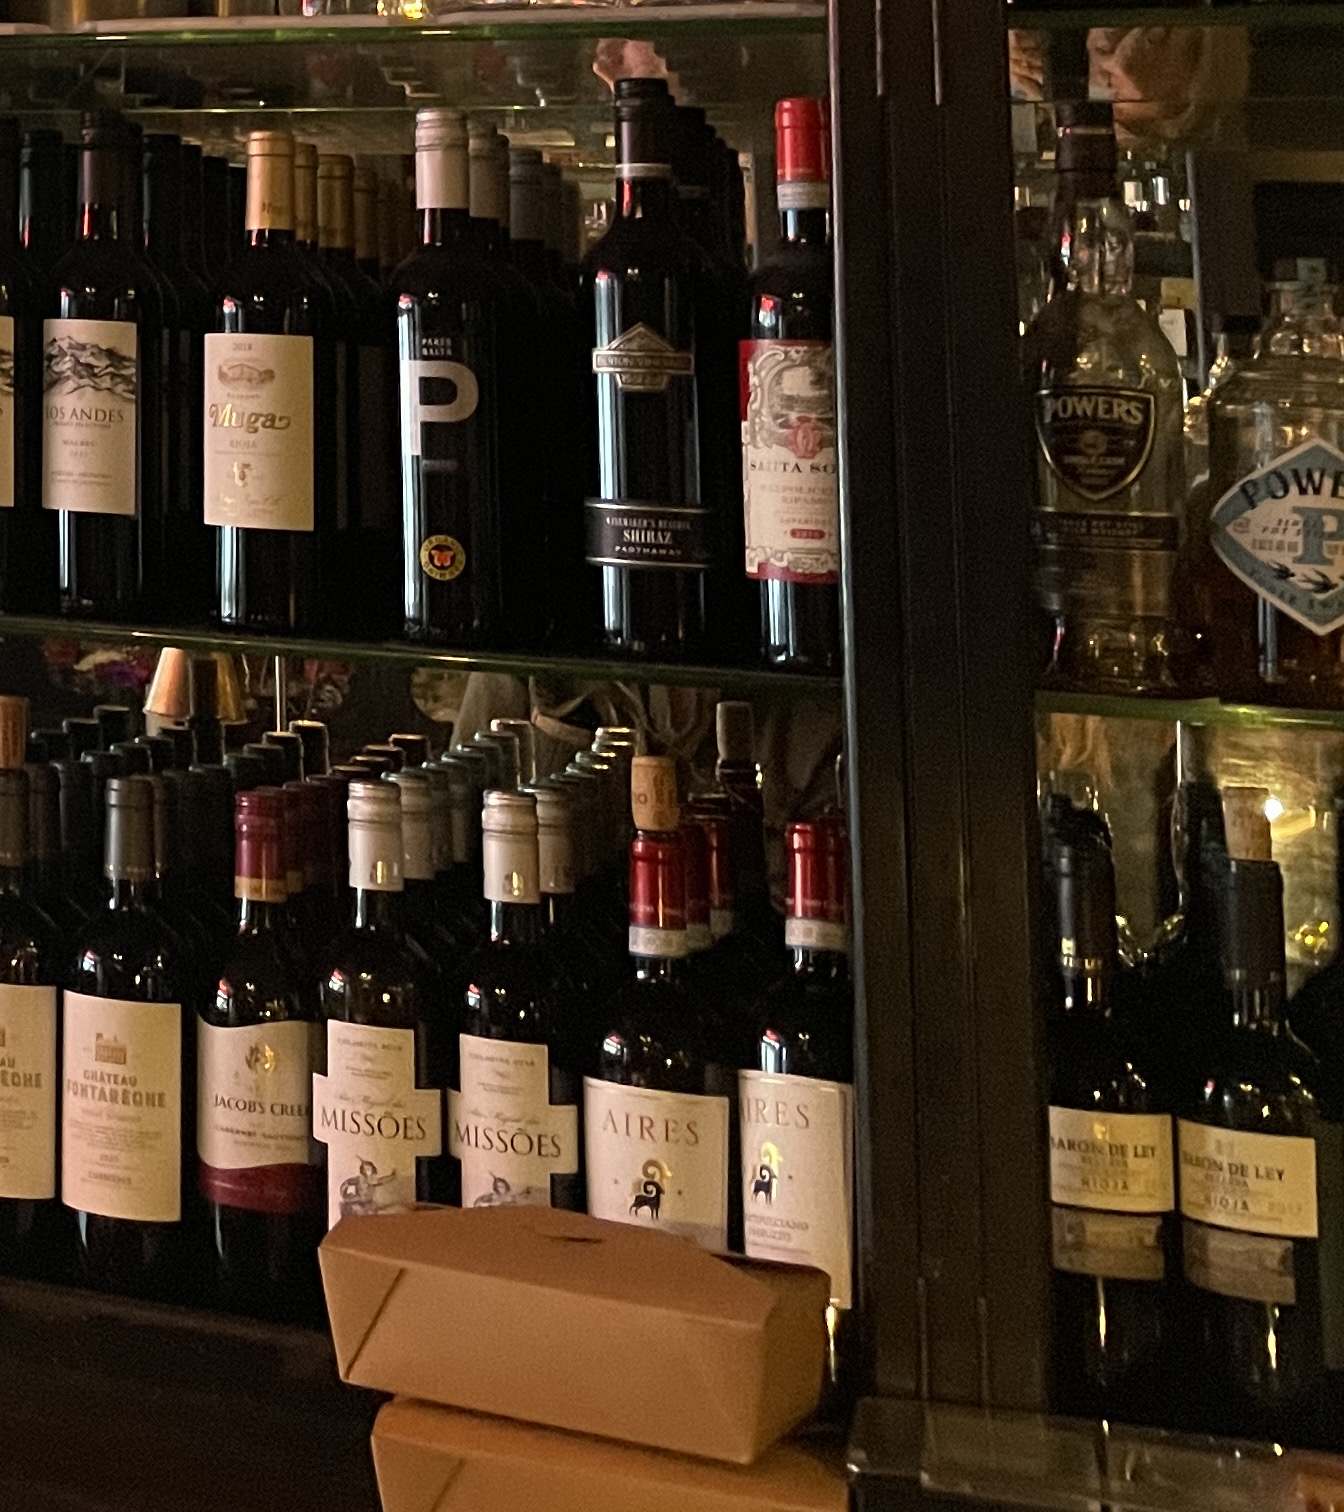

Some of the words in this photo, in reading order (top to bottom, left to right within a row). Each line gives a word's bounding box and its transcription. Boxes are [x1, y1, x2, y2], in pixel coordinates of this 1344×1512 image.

[46, 405, 69, 420] LOS
[72, 407, 124, 423] ANDES
[207, 404, 290, 433] Muga
[1043, 397, 1144, 424] POWERS
[623, 528, 673, 545] SHIRAZ
[214, 1093, 266, 1117] JACOB'S
[320, 1104, 427, 1142] MISSÕES
[601, 1106, 700, 1146] AIRES
[455, 1120, 563, 1159] MISSÕES
[1109, 1142, 1128, 1158] DE
[1132, 1145, 1156, 1160] LEY
[1226, 1161, 1248, 1180] DE
[1253, 1165, 1285, 1183] LEY
